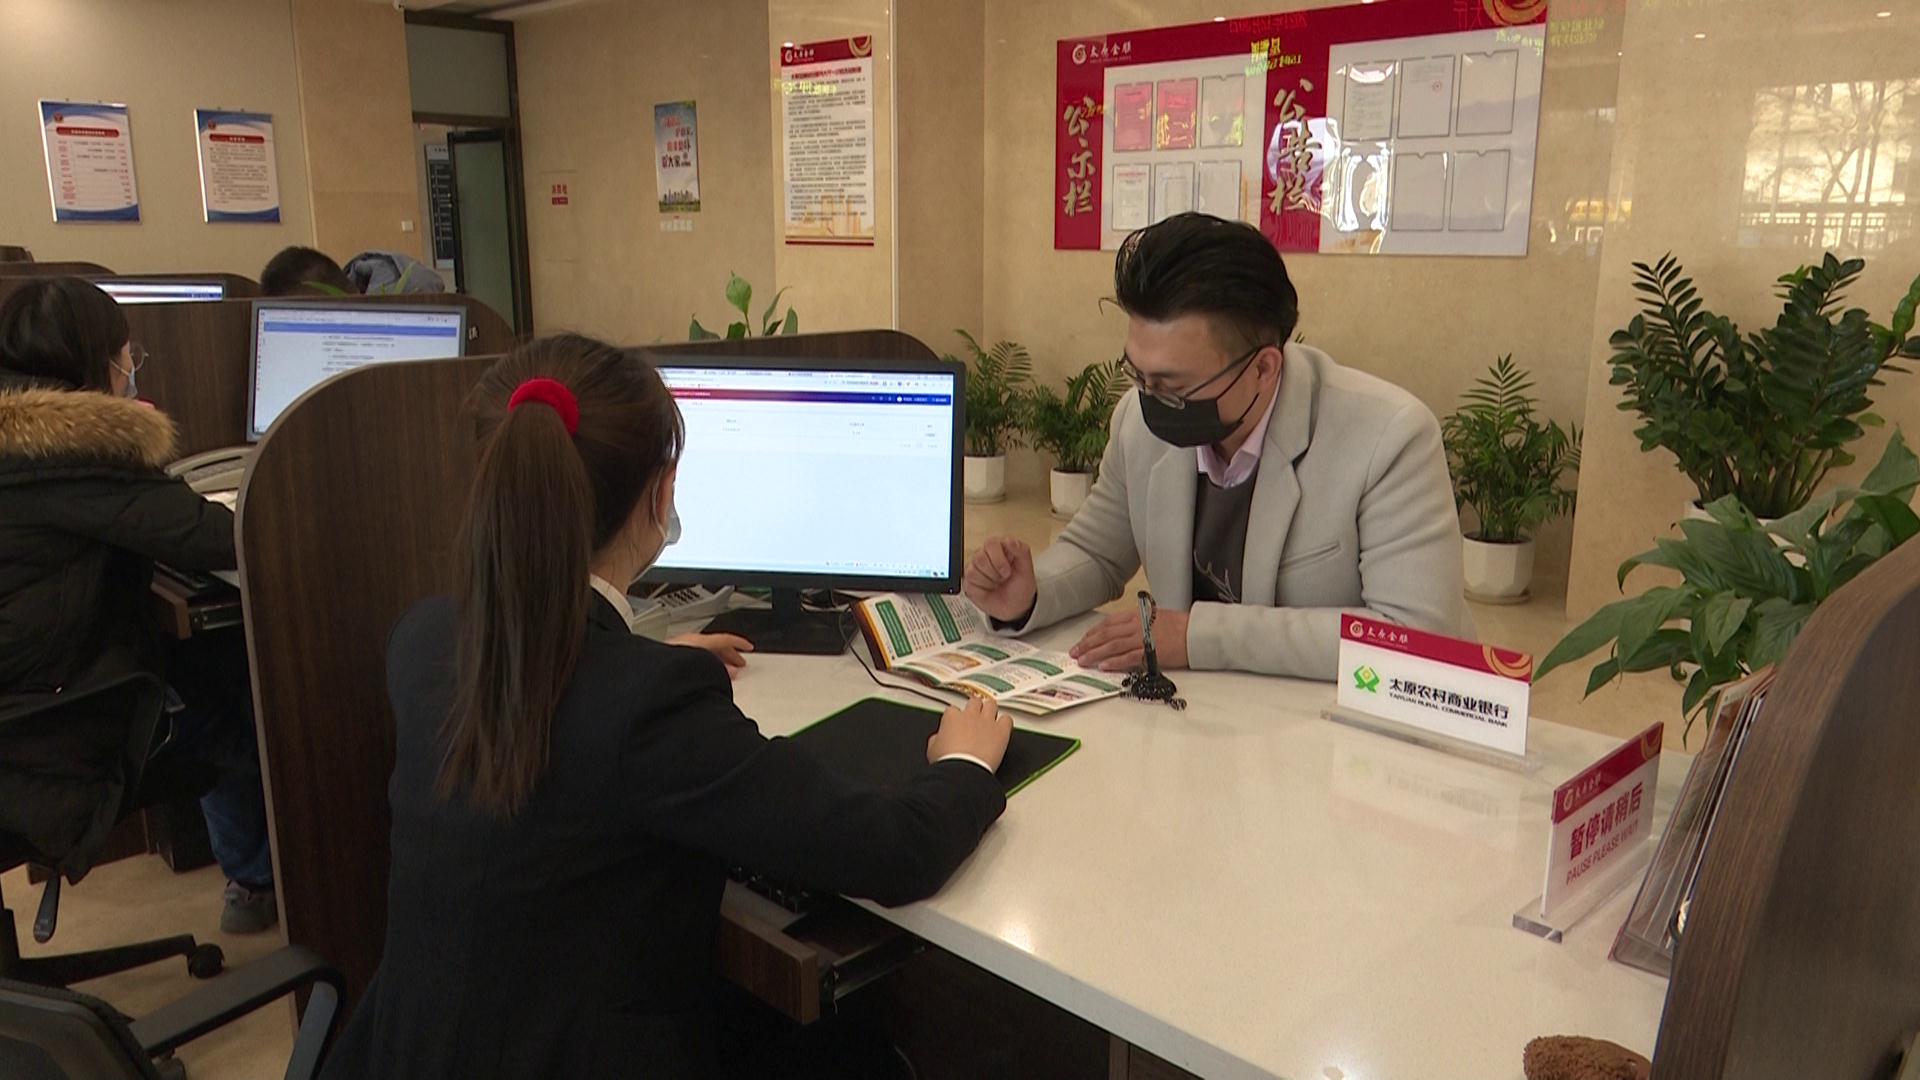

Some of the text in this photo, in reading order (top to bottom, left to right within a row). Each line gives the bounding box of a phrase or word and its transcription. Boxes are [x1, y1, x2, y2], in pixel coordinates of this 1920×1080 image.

[1063, 96, 1096, 217] 公示栏
[1389, 678, 1510, 719] 太原农村商业银行
[1570, 781, 1643, 860] 暂停请稍后
[1566, 854, 1593, 886] PAUSE
[1593, 833, 1621, 865] PLEASE
